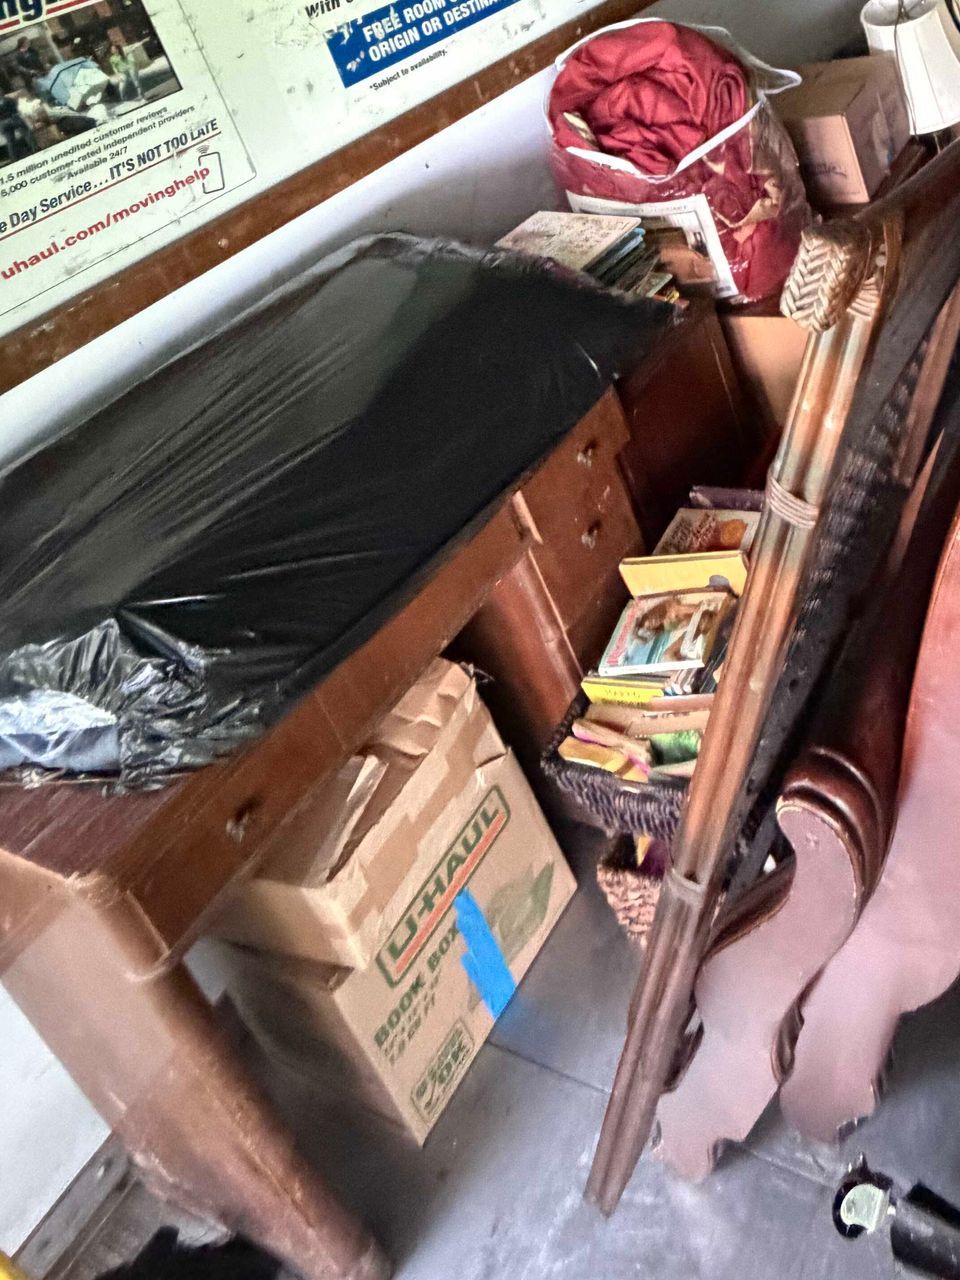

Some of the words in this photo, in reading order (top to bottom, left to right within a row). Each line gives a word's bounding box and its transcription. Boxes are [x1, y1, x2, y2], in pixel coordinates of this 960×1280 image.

[362, 10, 402, 42] FREE
[369, 32, 420, 62] ORIGIN
[422, 16, 442, 35] OR
[401, 68, 409, 76] to
[9, 206, 37, 227] Day
[109, 158, 135, 180] IT'S
[137, 144, 162, 167] NOT
[164, 133, 188, 153] TOO
[191, 118, 219, 141] LATE
[17, 160, 48, 177] million
[51, 139, 92, 162] unedited
[93, 120, 134, 143] customer
[136, 107, 168, 125] reviews
[30, 147, 102, 183] customer-rated
[103, 123, 156, 150] independent
[158, 105, 195, 129] providers
[67, 156, 108, 180] Available
[1, 167, 210, 279] uhaul.com/movinghelp
[388, 807, 500, 961] U-HAUL
[374, 971, 426, 1048] BOOK
[427, 922, 460, 972] BOX
